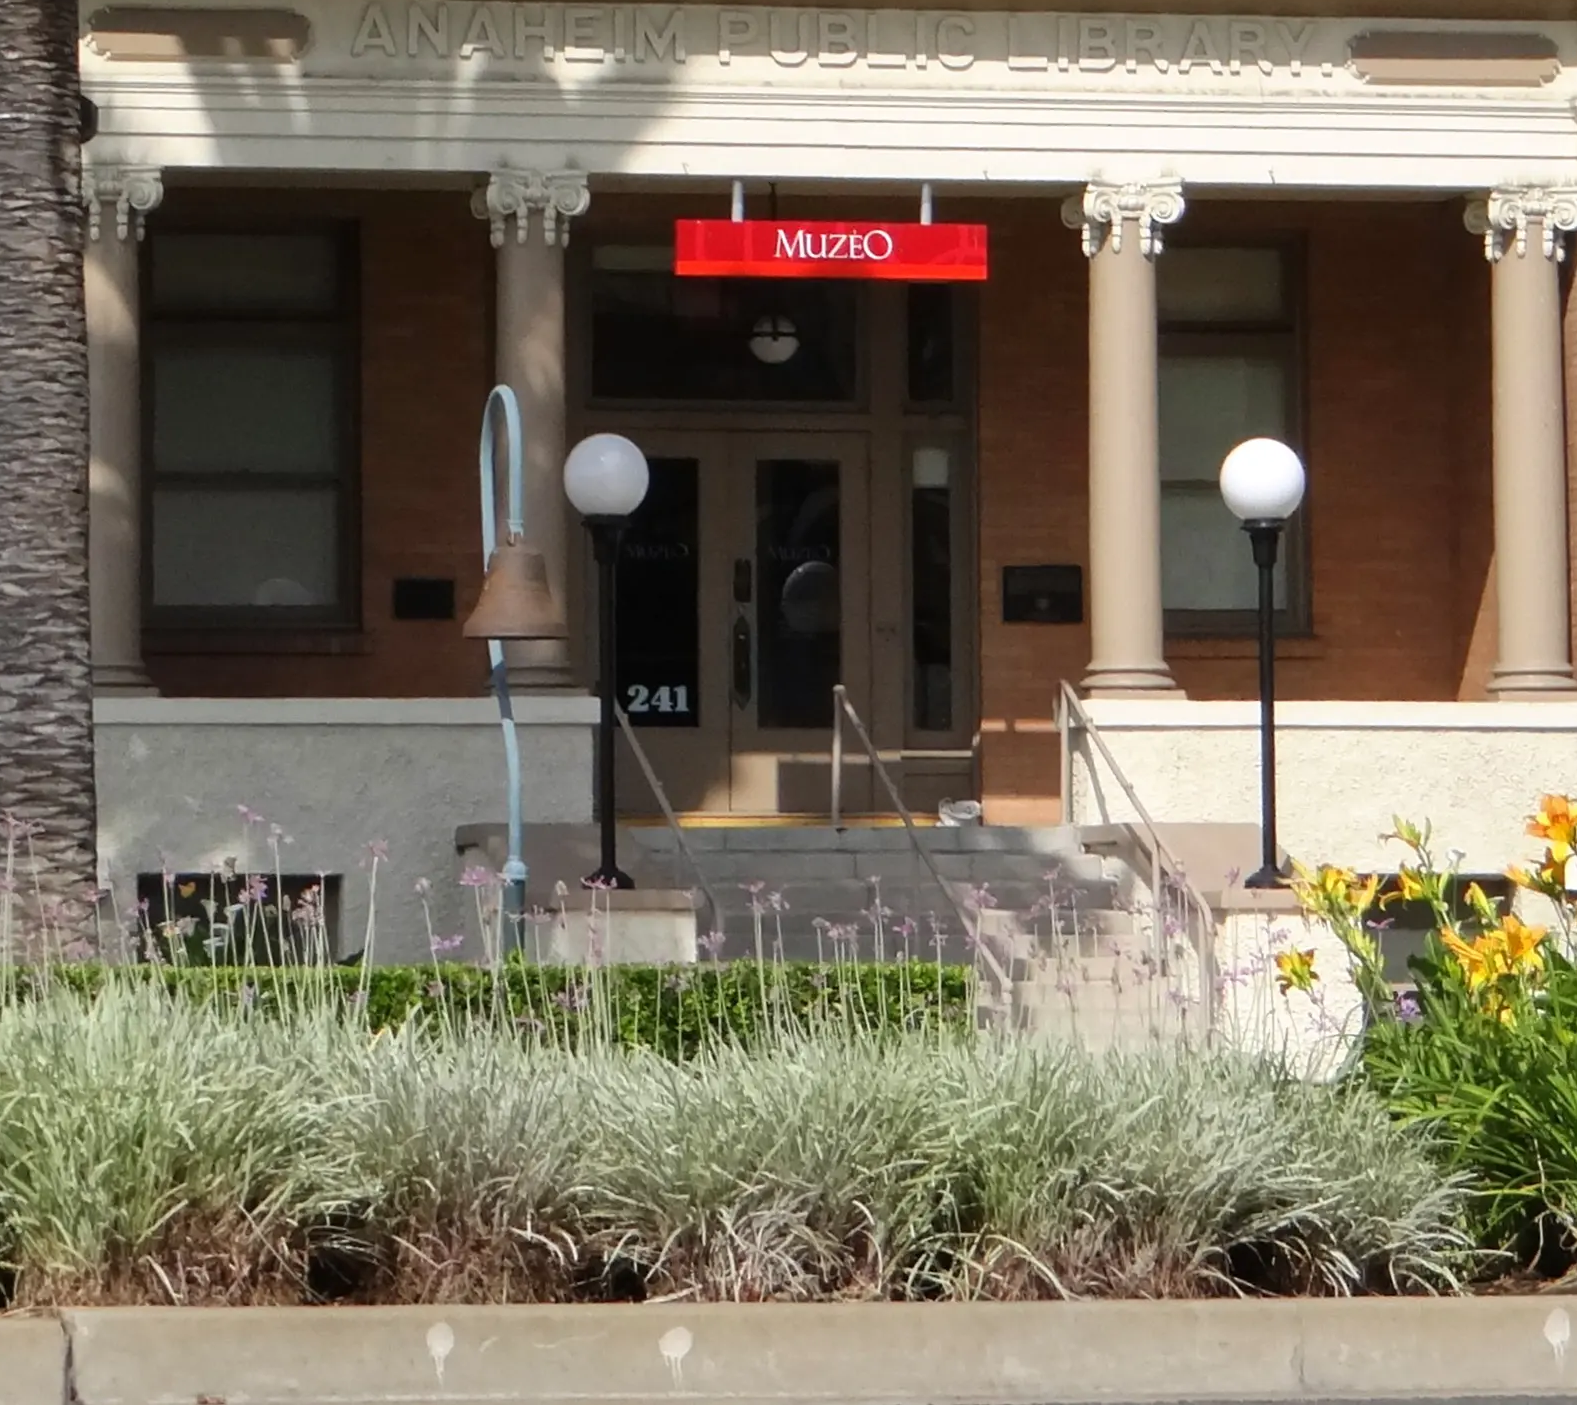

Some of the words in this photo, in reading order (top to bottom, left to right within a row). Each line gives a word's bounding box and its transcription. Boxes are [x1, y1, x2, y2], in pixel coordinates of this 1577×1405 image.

[350, 2, 687, 65] ANAHEIM
[718, 9, 975, 68] PUBLIC
[627, 684, 690, 712] 241
